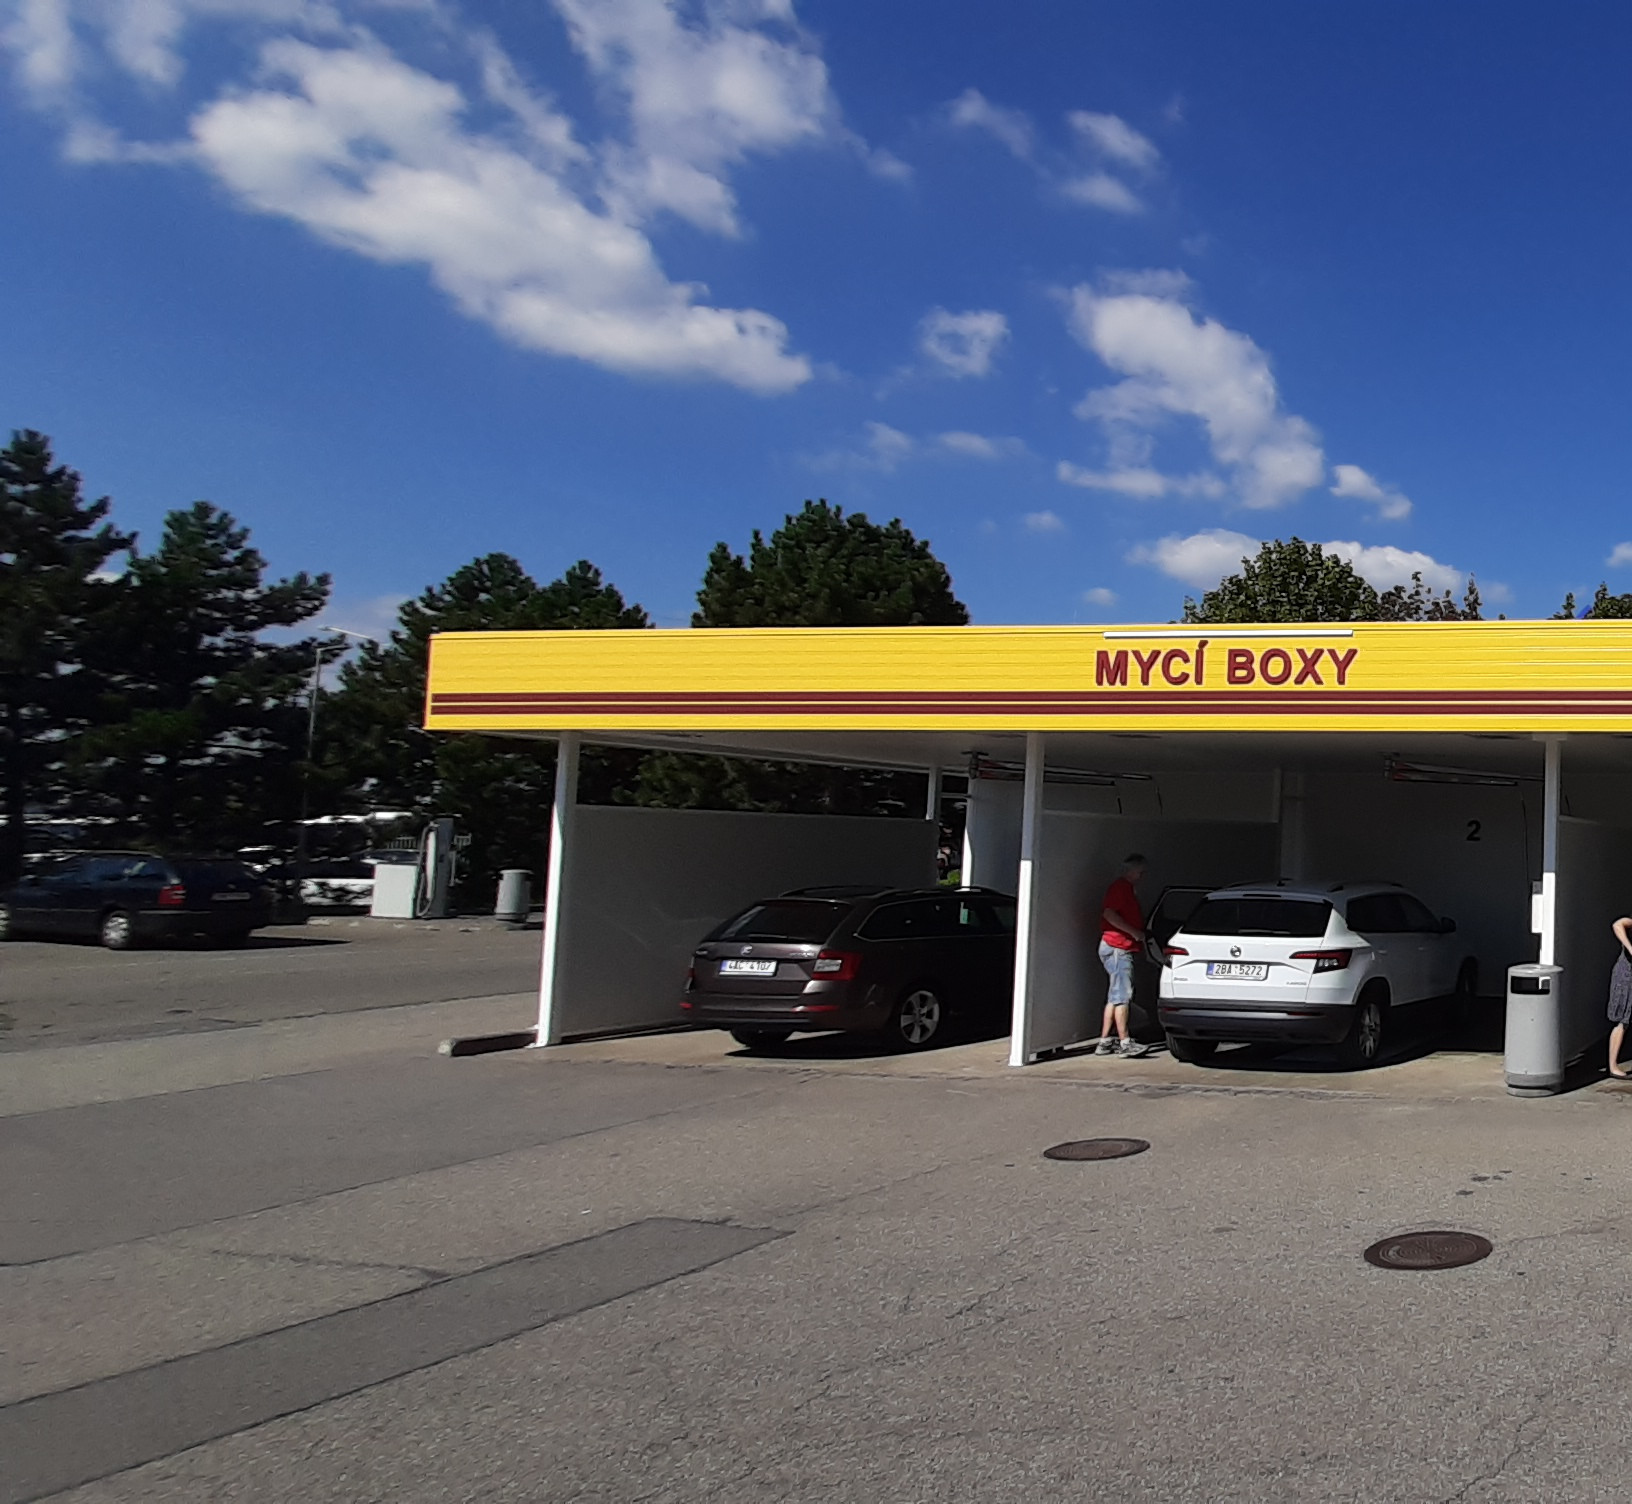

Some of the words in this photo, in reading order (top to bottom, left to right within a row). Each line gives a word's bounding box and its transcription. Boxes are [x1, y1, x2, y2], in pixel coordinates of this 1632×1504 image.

[1096, 640, 1208, 686] MYCÍ
[1227, 648, 1358, 685] BOXY
[1467, 820, 1481, 841] 2
[1215, 964, 1232, 975] 2BA
[1239, 964, 1263, 976] 5272
